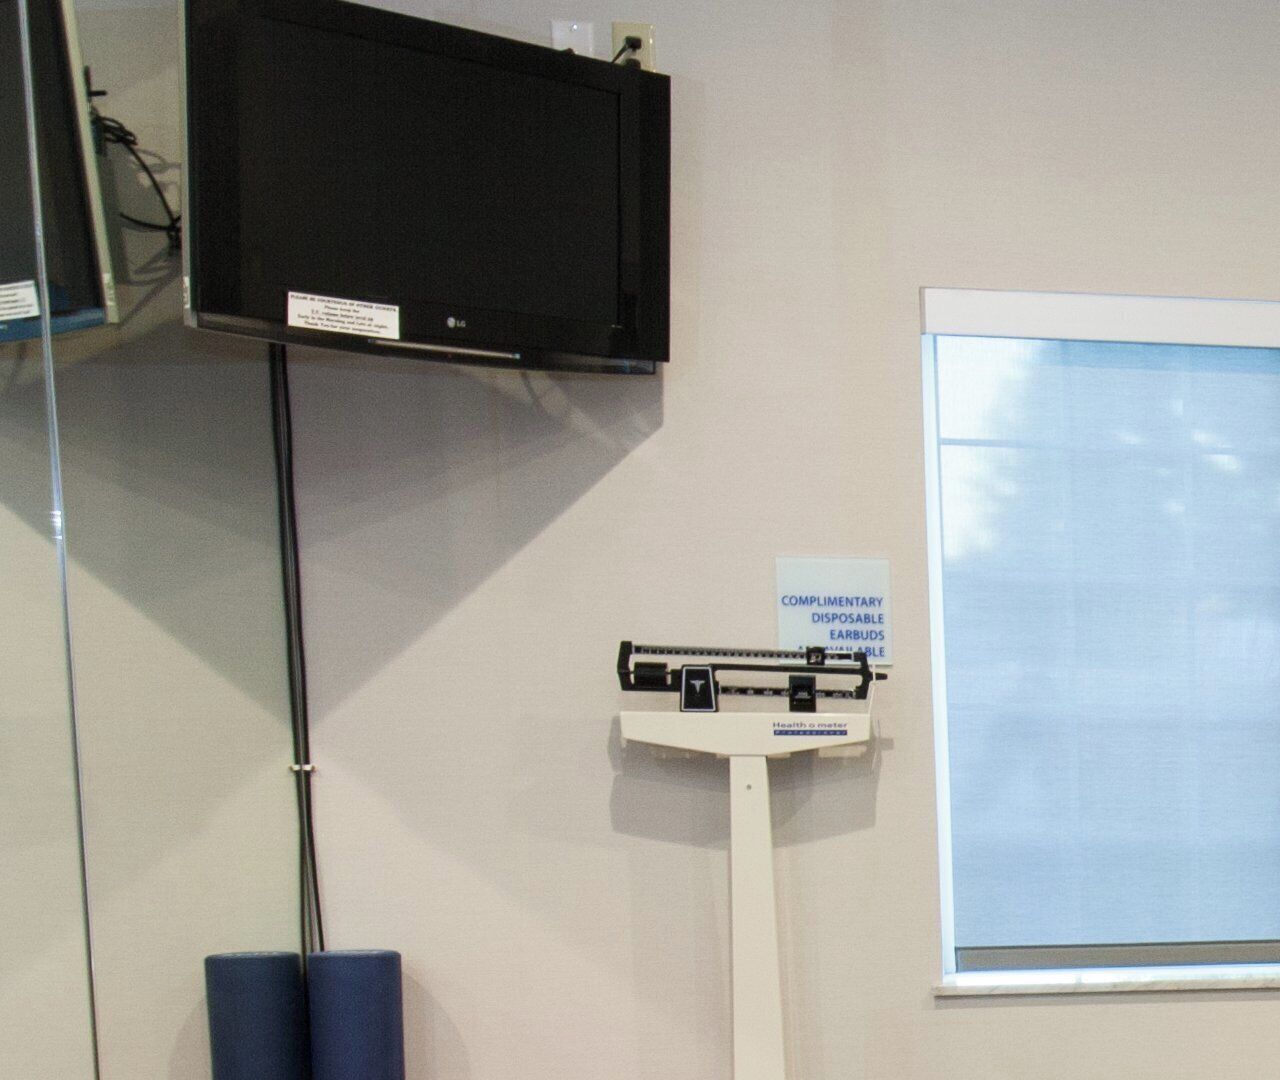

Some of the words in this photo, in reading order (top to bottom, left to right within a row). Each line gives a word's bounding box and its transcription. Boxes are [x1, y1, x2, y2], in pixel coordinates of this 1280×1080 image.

[781, 595, 883, 607] COMPLIMENTARY
[812, 612, 884, 624] DISPOSABLE
[830, 629, 885, 641] EARBUDS
